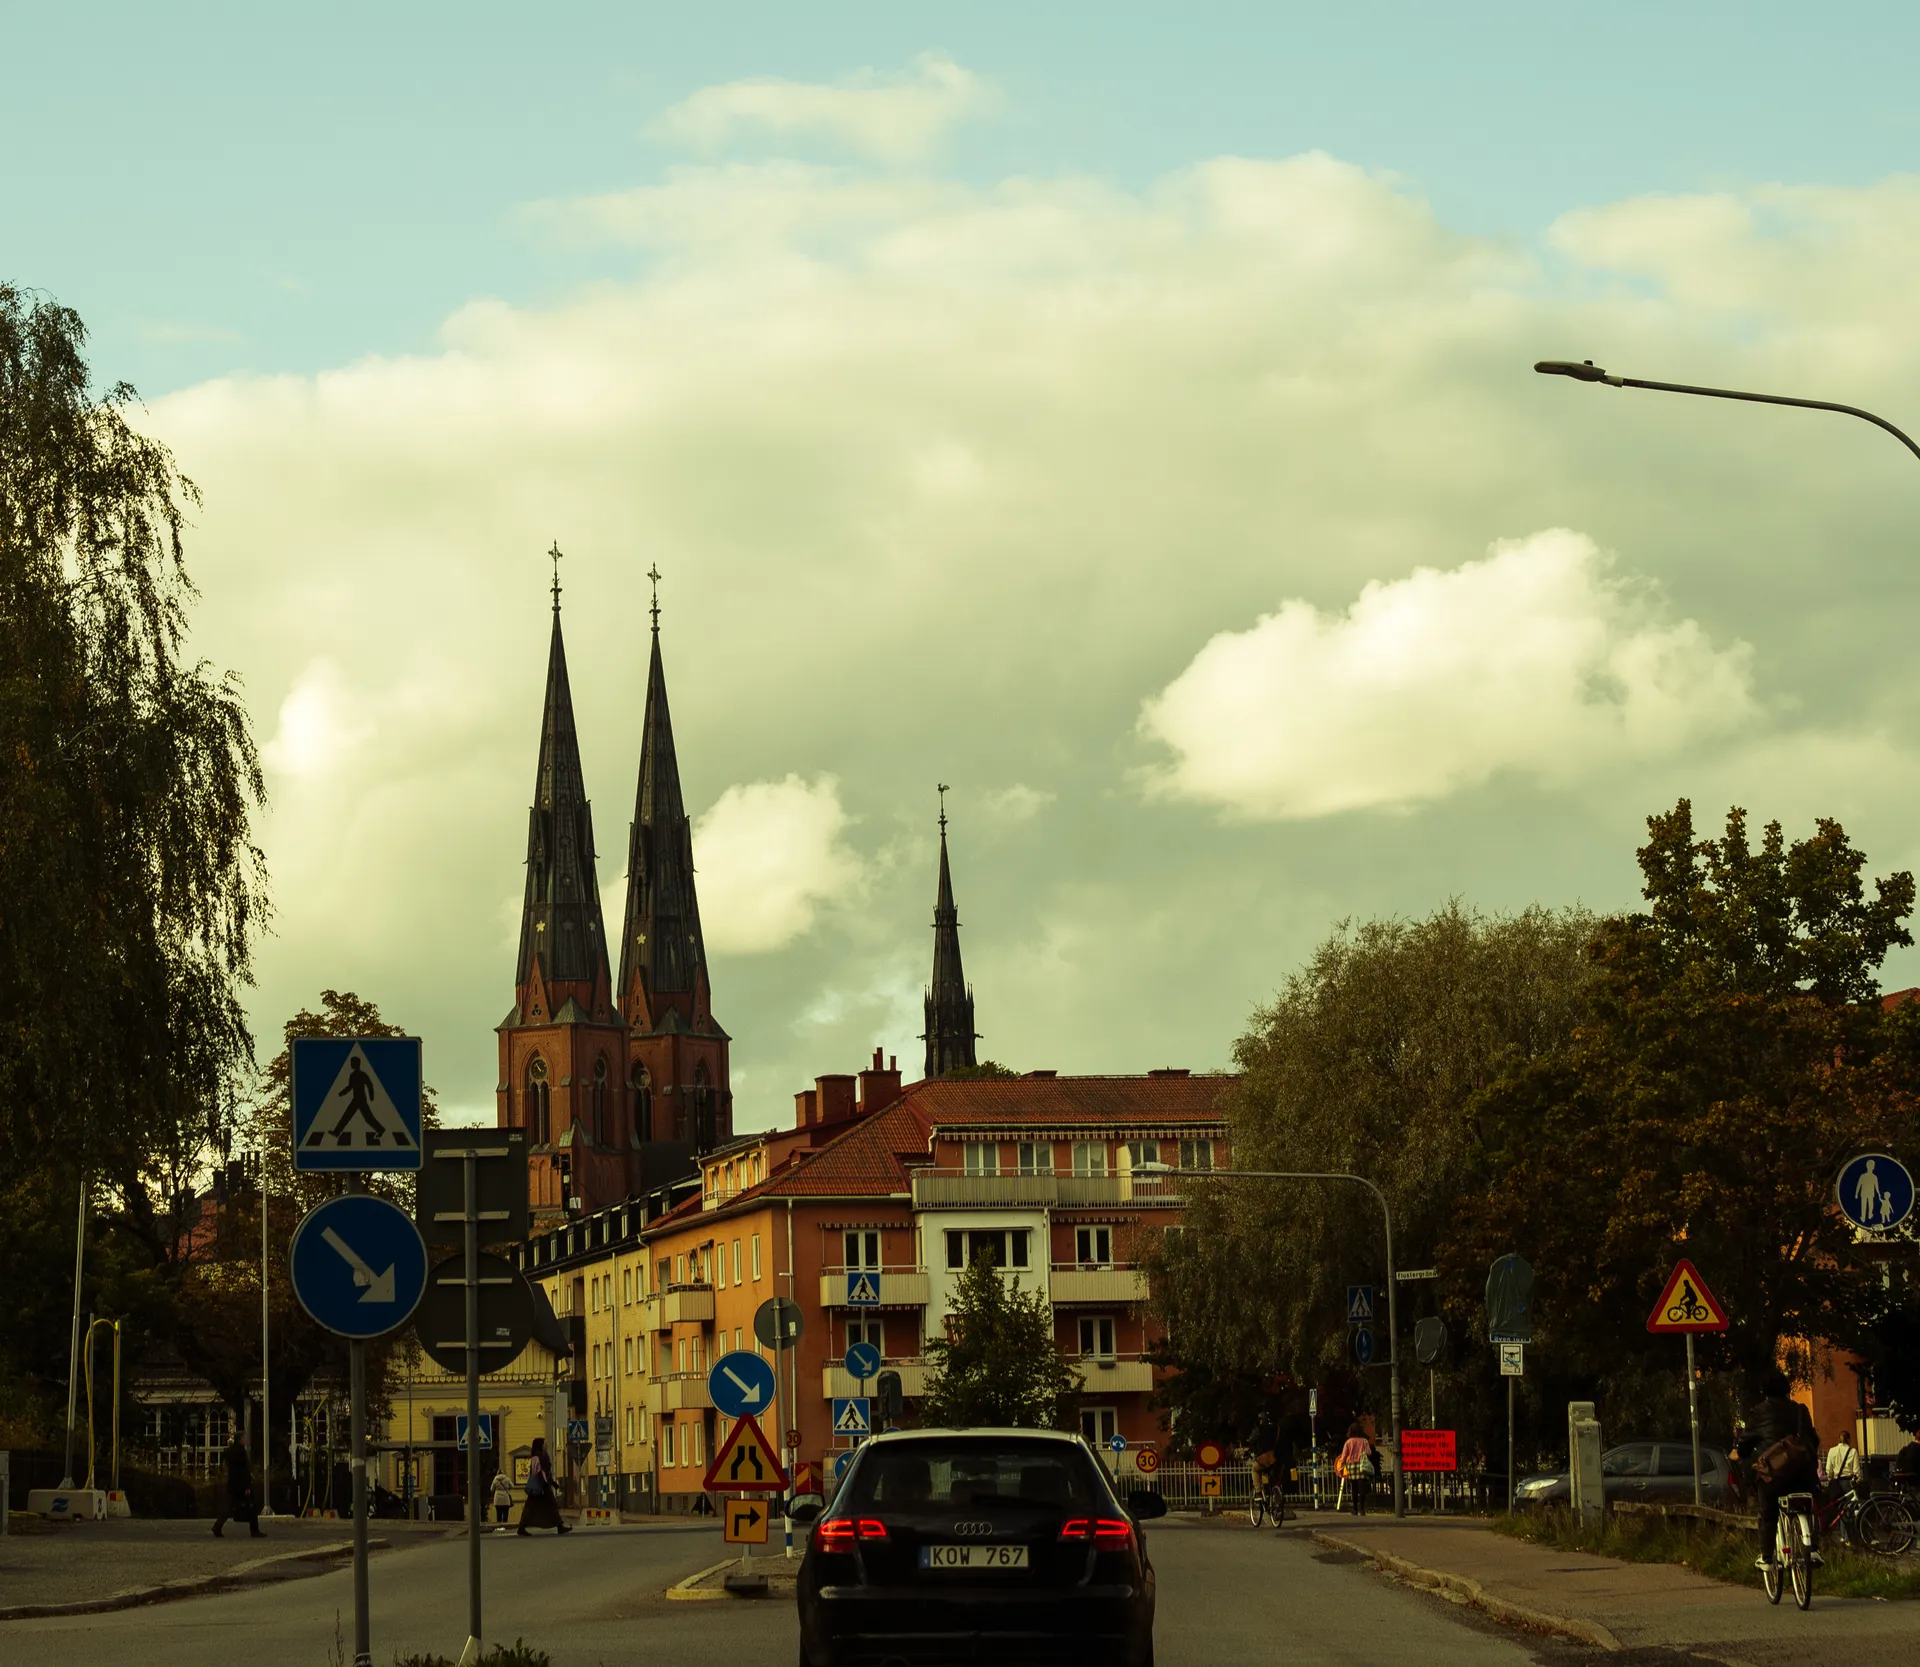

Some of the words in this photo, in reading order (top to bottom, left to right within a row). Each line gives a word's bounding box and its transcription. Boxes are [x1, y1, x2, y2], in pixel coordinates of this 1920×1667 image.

[787, 1434, 799, 1444] 30
[1140, 1455, 1156, 1467] 30
[933, 1547, 971, 1565] KOW
[986, 1547, 1024, 1565] 767
